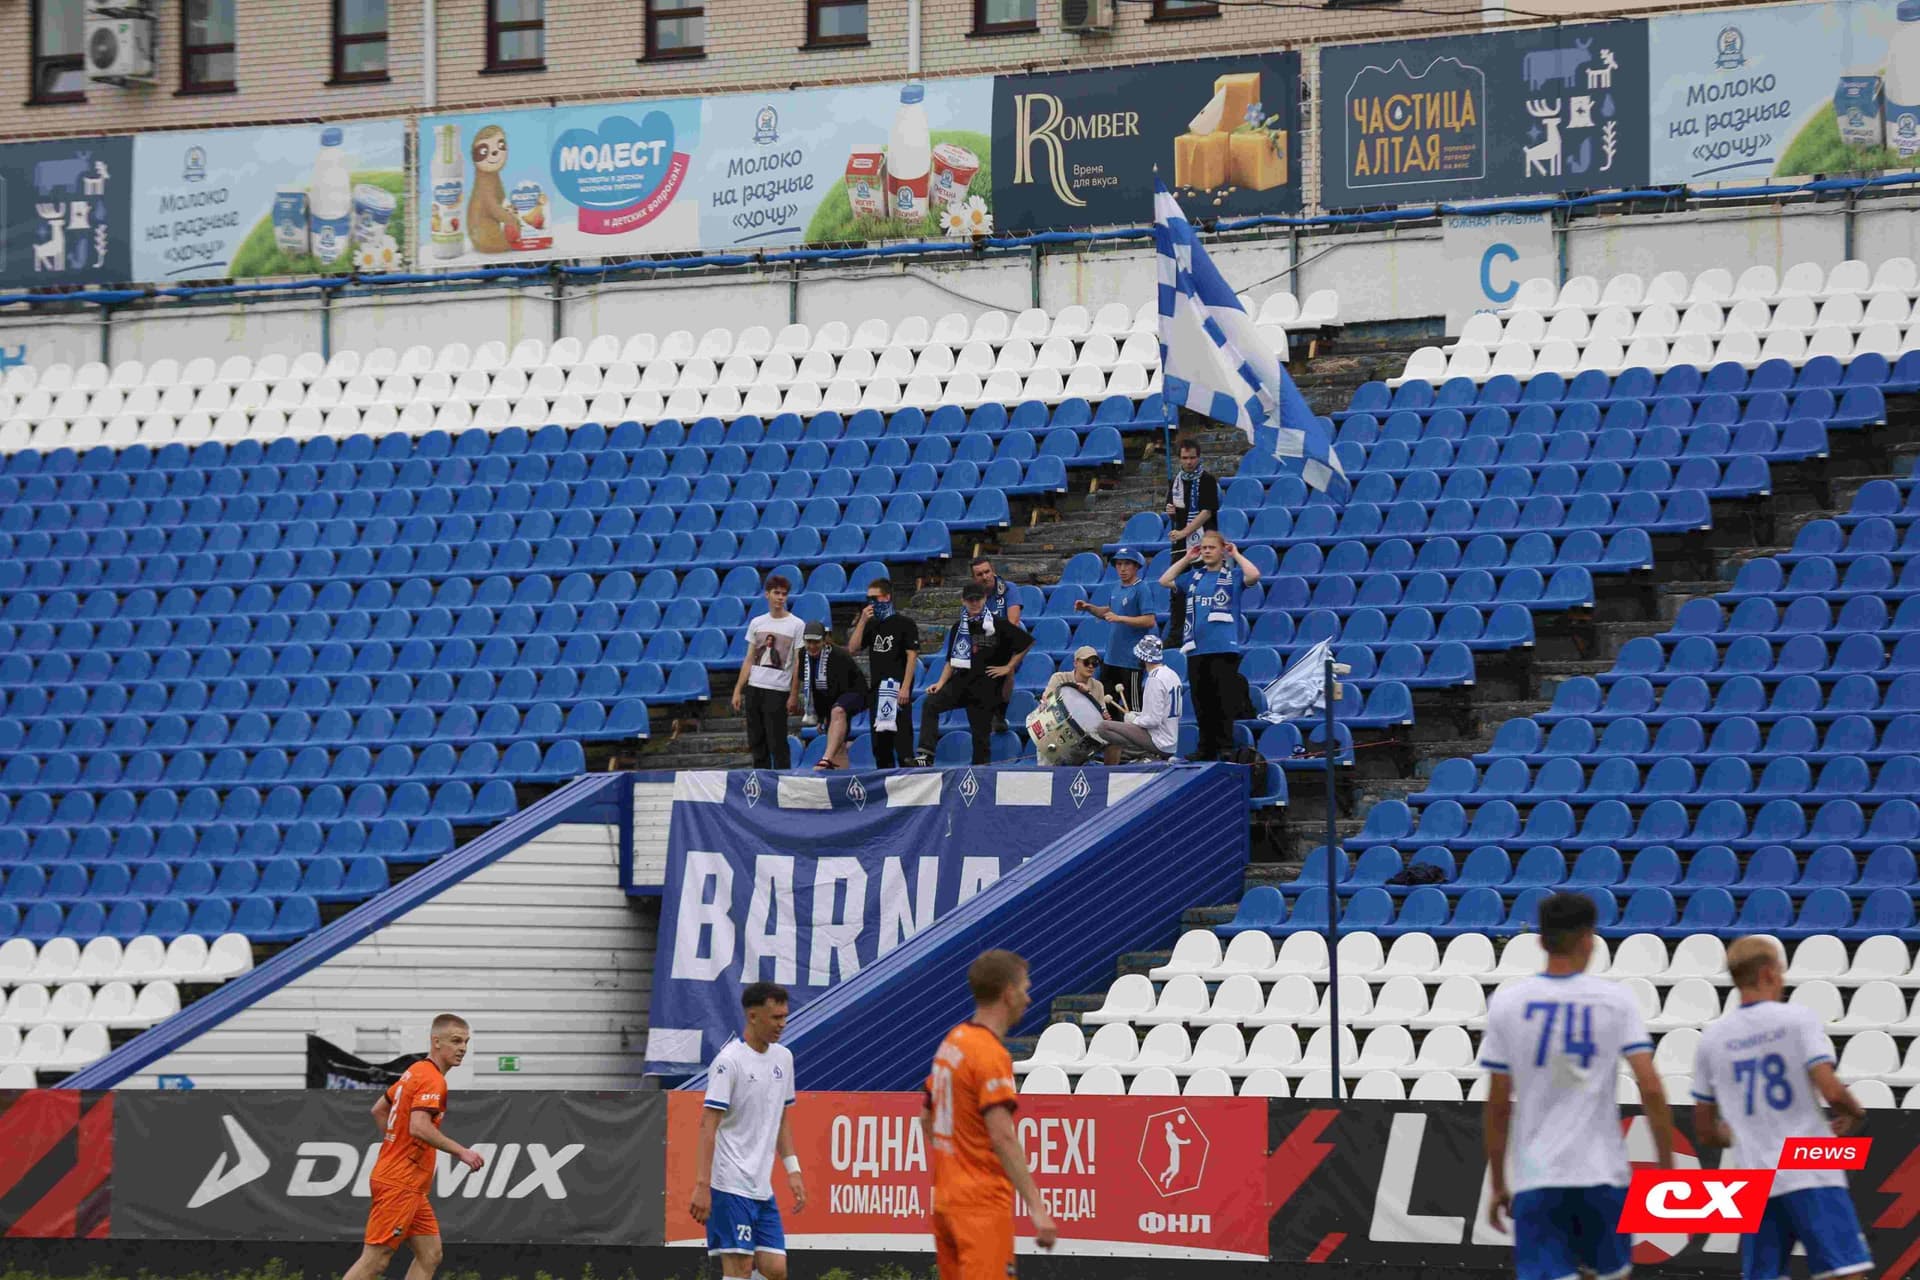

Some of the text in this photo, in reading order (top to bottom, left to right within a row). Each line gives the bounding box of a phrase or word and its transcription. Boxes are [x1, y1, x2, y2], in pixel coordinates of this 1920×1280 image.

[1687, 74, 1776, 106] Молоко
[1353, 89, 1476, 134] ЧАСТИЦА
[1669, 100, 1791, 138] на разные
[560, 140, 667, 172] МОДЕСТ
[1354, 134, 1440, 176] АЛТАЯ
[1692, 133, 1772, 161] «хочу»
[727, 149, 803, 179] Молоко
[712, 173, 815, 207] на разные
[1073, 176, 1118, 188] для вкуса
[159, 188, 228, 214] Молоко
[732, 203, 799, 230] «хочу»
[145, 211, 239, 241] на разные
[670, 851, 1032, 986] BARN
[1524, 1001, 1597, 1070] 74
[1732, 1053, 1793, 1116] 78
[831, 1115, 1096, 1178] ОДНА СЕХ!
[830, 1184, 926, 1219] КОМАНДА,
[1015, 1187, 1096, 1221] ПБЕДА!
[736, 1224, 752, 1241] 73
[1138, 1212, 1211, 1234] ФНЛ
